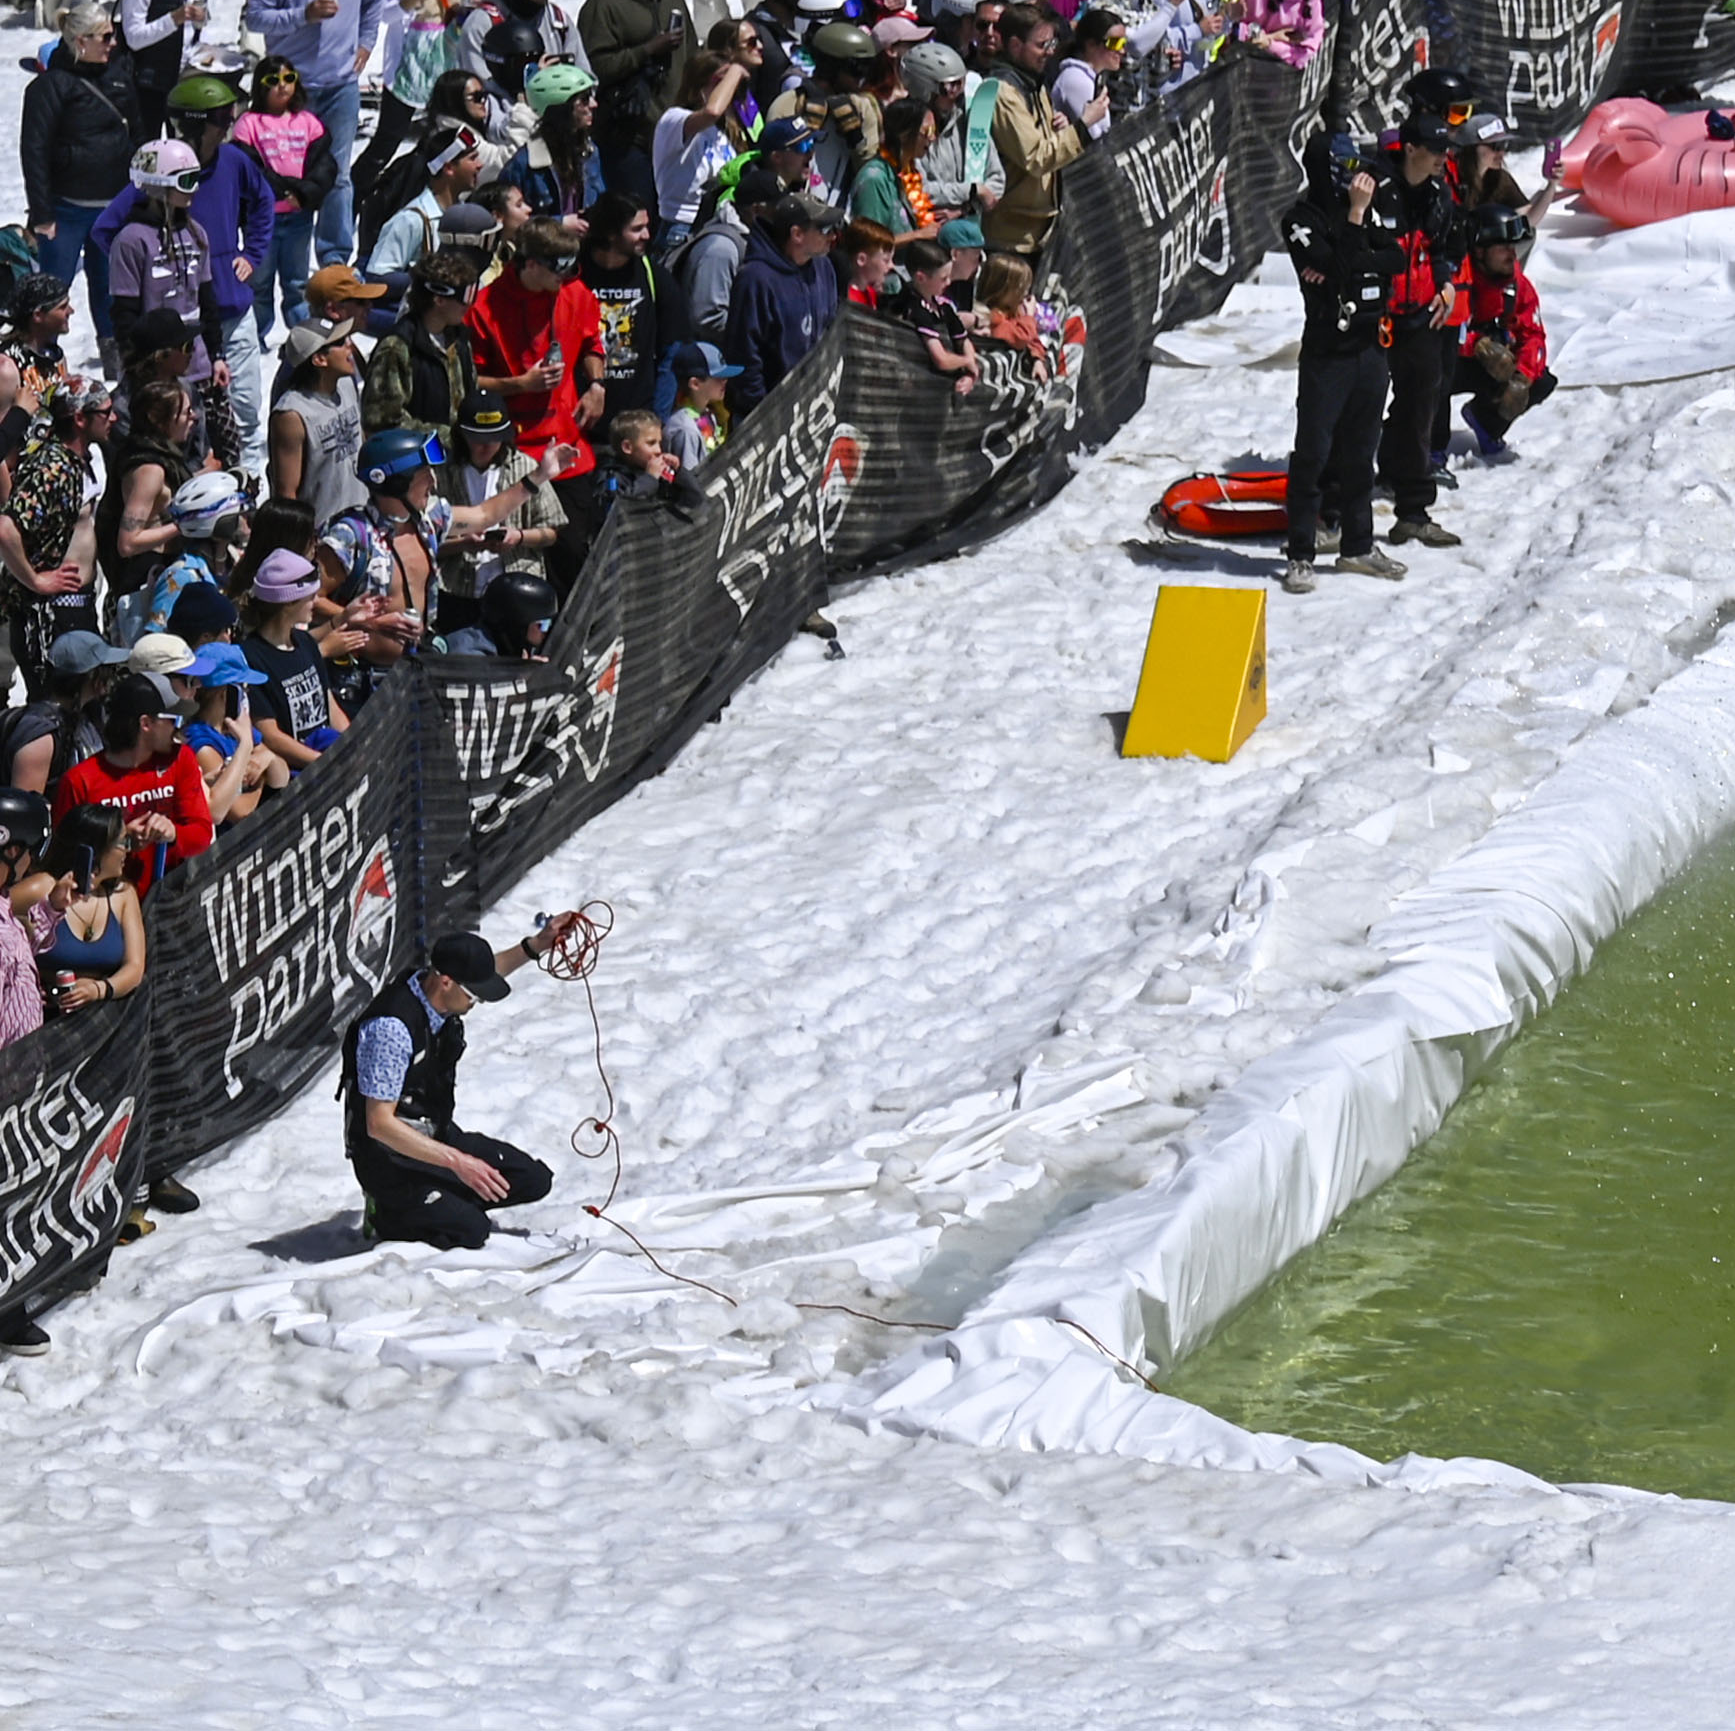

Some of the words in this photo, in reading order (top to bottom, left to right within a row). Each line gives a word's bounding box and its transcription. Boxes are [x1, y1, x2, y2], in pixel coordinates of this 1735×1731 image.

[1113, 98, 1216, 229] Winter
[101, 784, 175, 809] FALCONS
[201, 774, 370, 984] Winter
